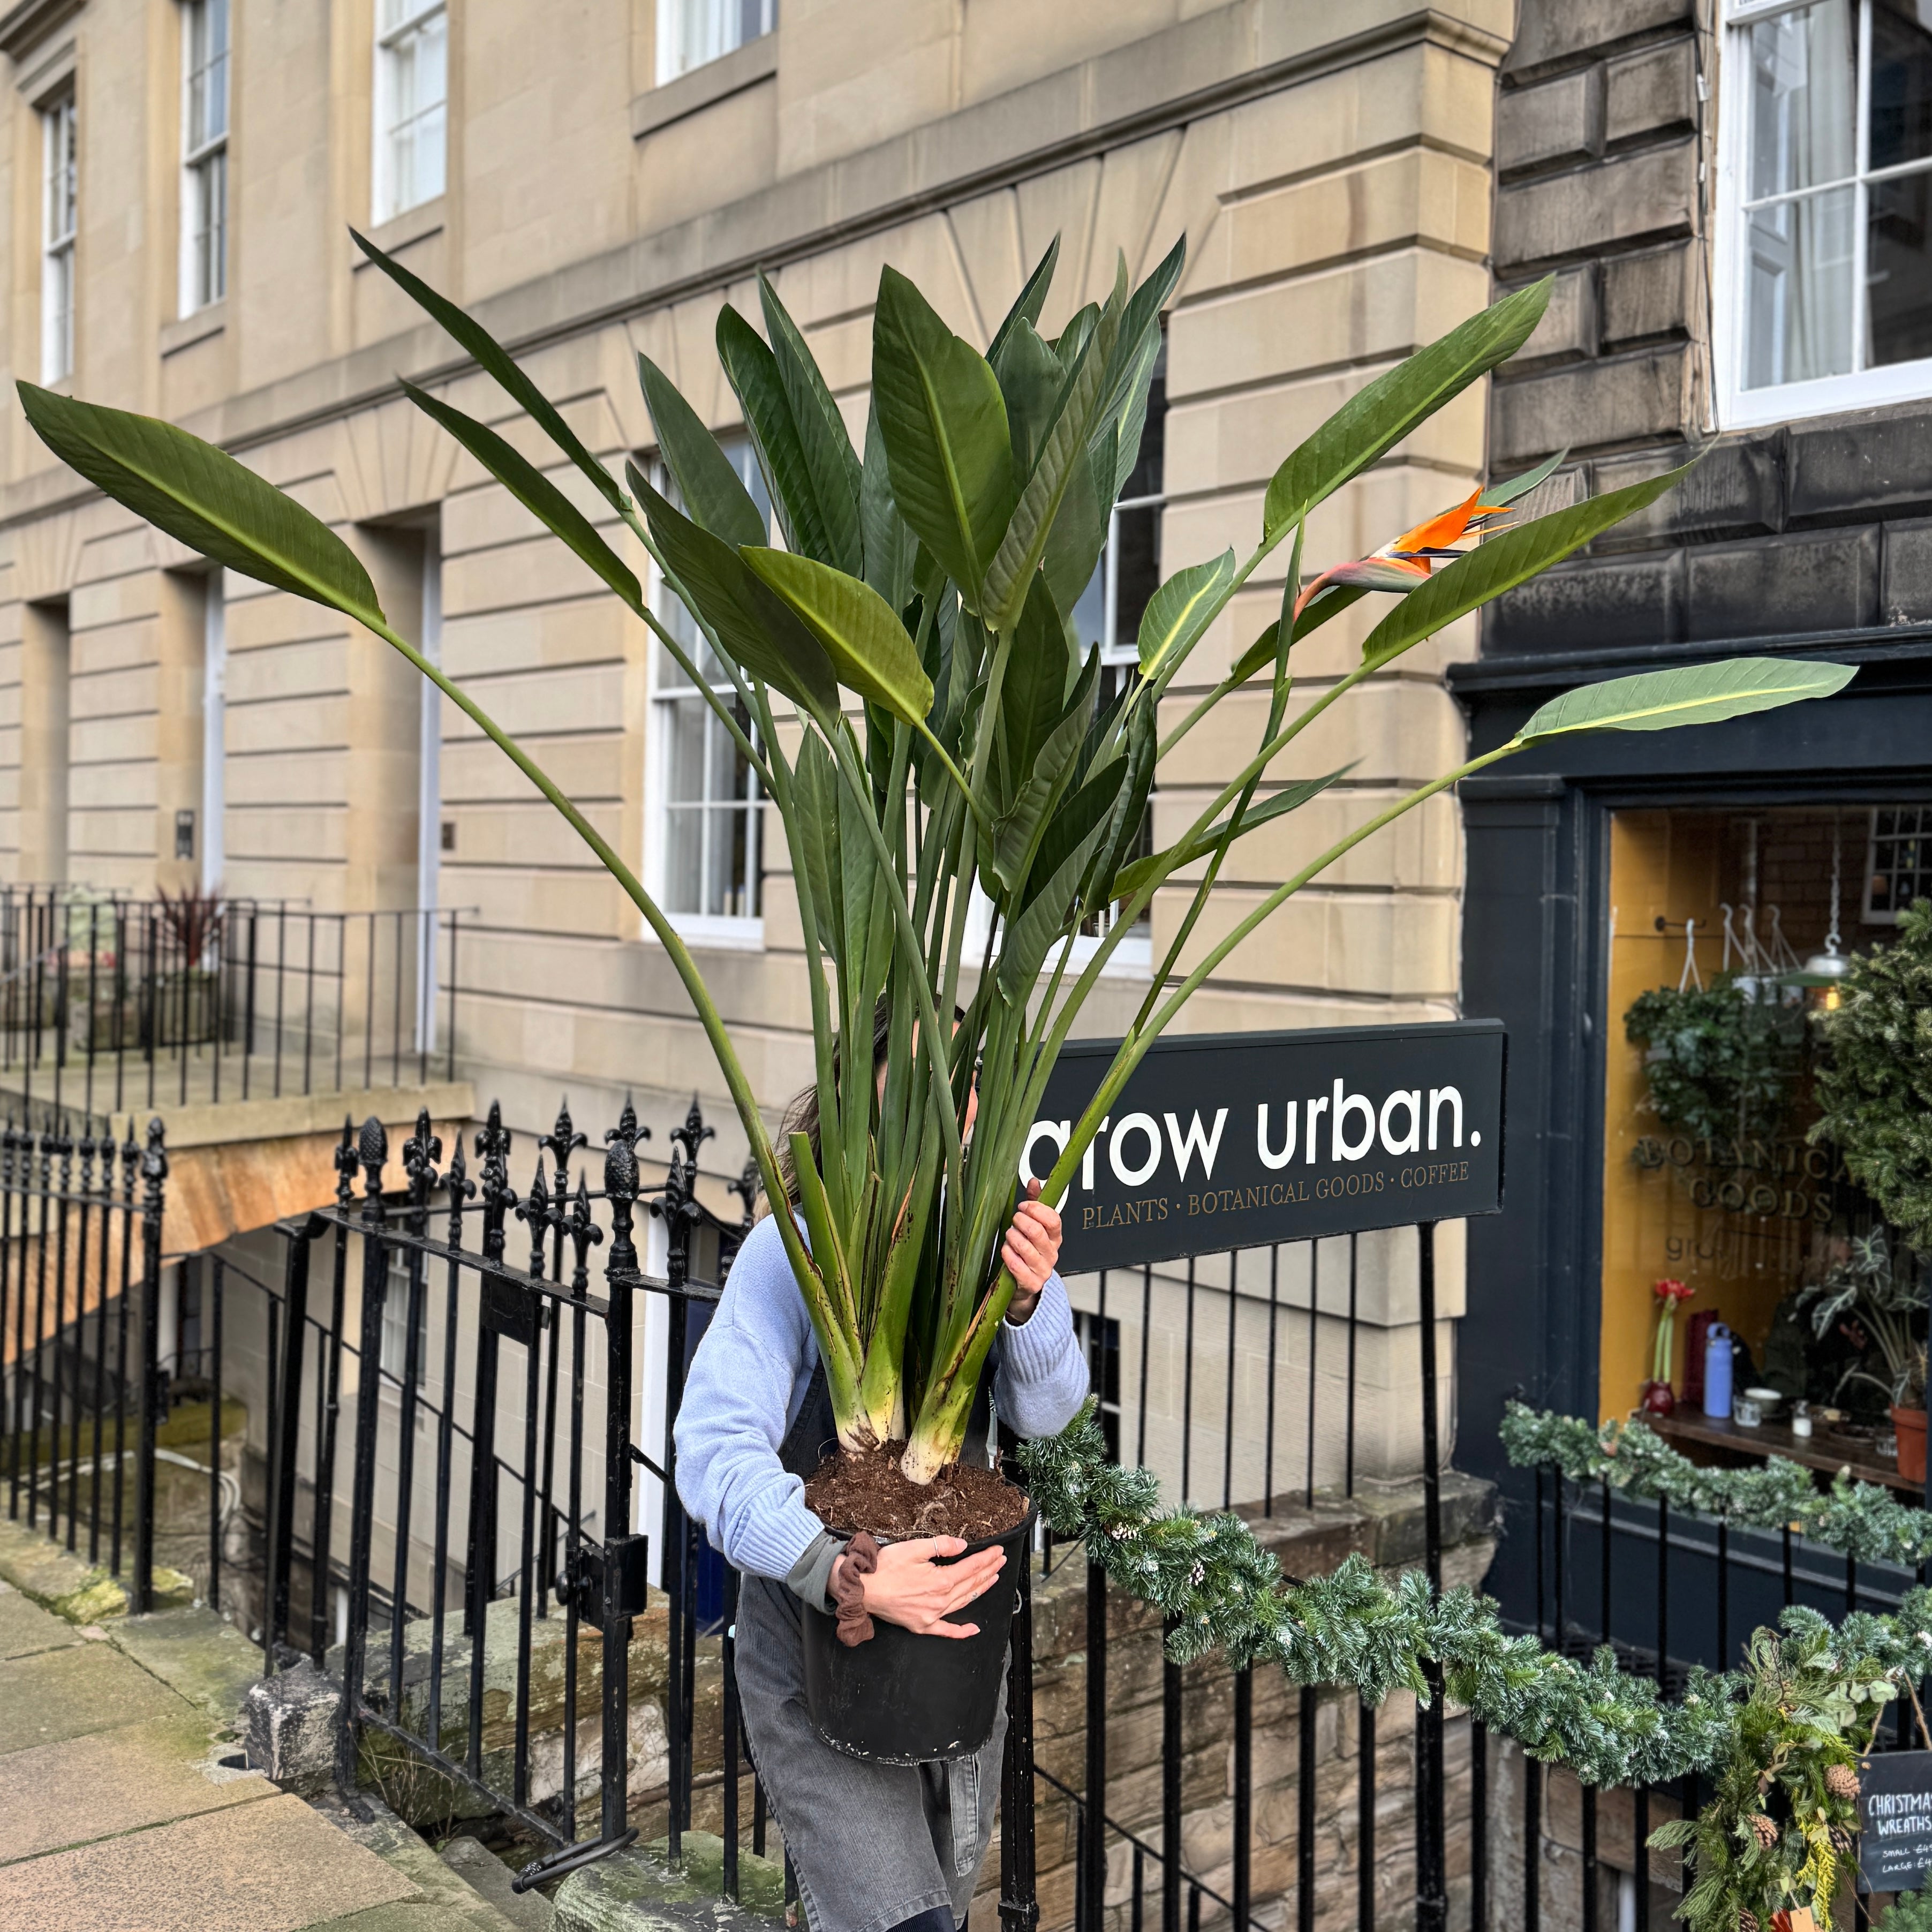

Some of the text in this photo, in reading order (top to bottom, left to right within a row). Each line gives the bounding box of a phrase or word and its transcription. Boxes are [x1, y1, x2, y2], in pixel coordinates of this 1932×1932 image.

[1018, 1078, 1481, 1214] grow urban.
[1638, 1136, 1856, 1187] BOTANICA
[1082, 1161, 1469, 1229] PLANTS BOTANICAL GOODS COFFEE
[1688, 1179, 1833, 1223] GOODS
[1666, 1235, 1717, 1262] gro
[1868, 1792, 1932, 1816] CHRISTMA
[1877, 1815, 1932, 1836] WREATHS
